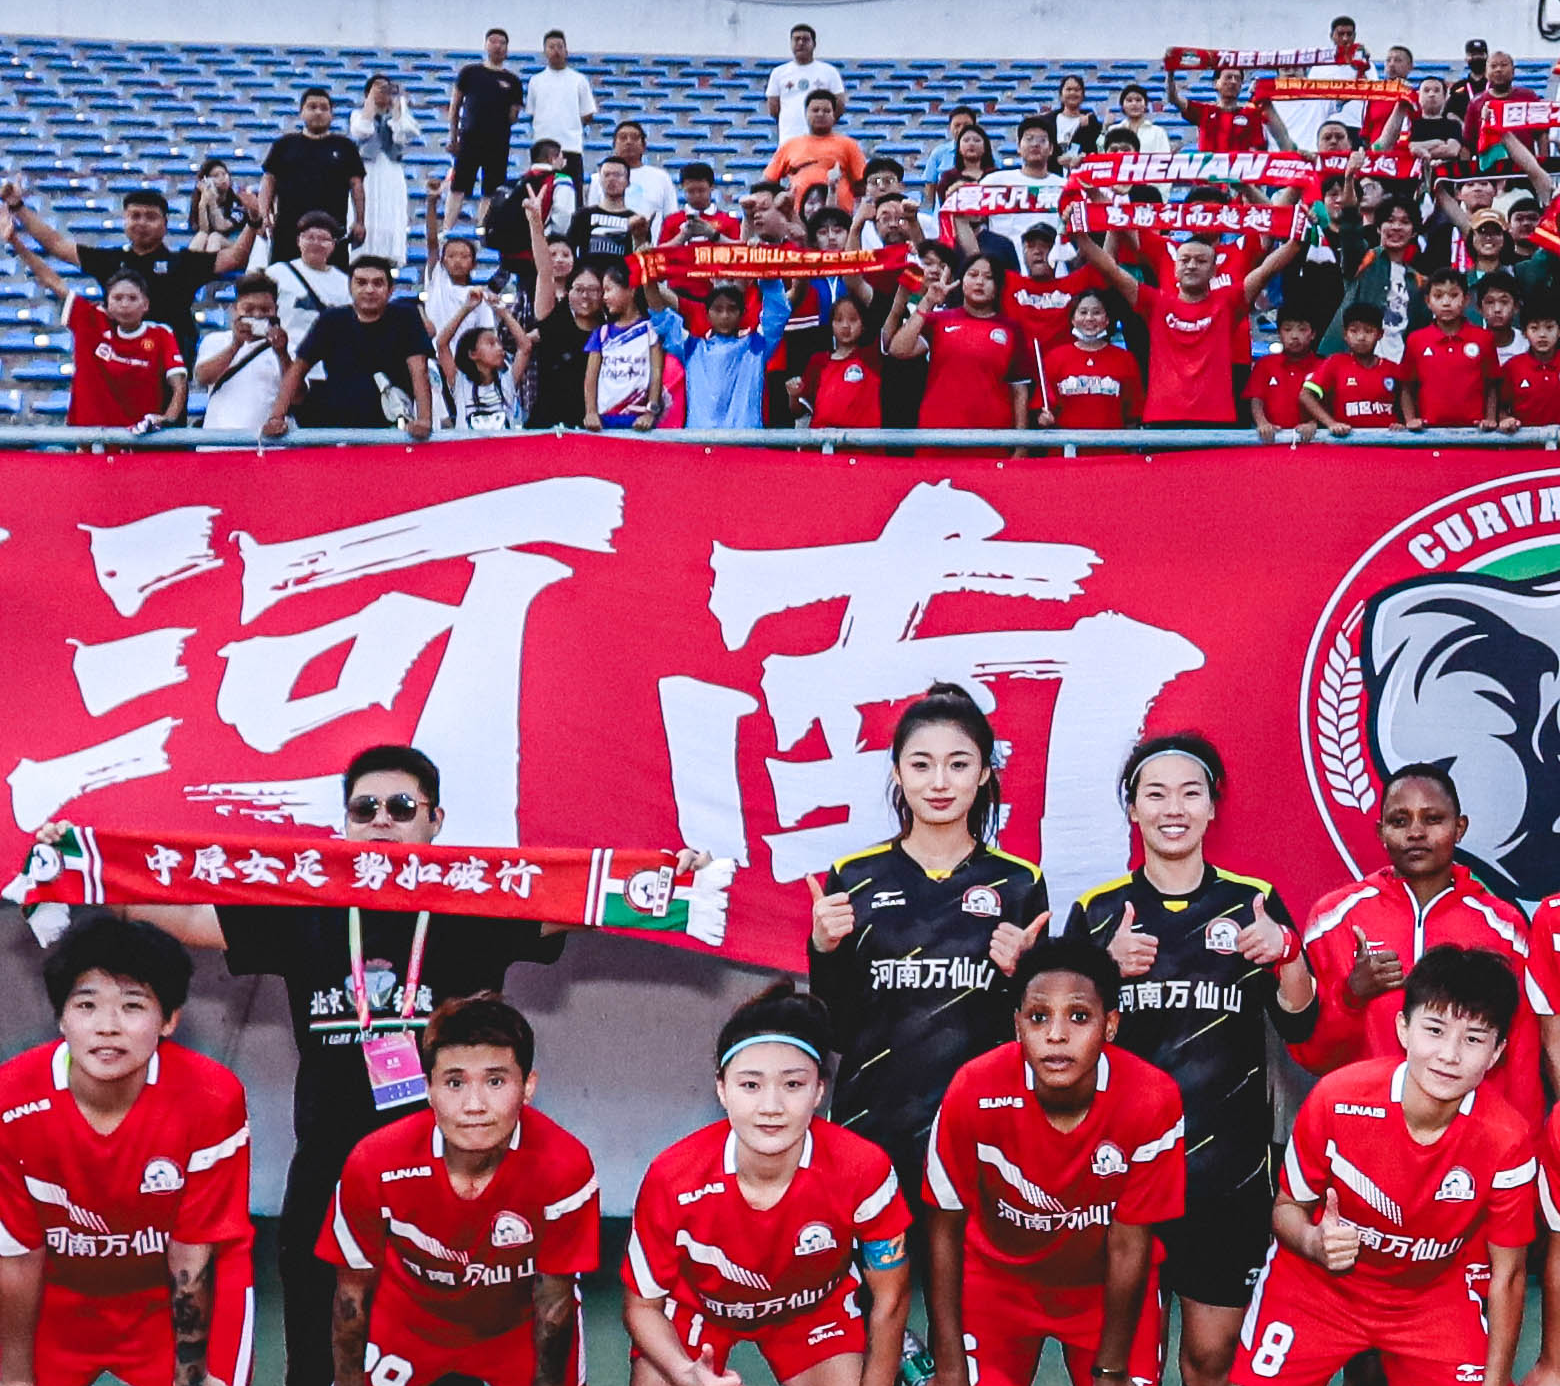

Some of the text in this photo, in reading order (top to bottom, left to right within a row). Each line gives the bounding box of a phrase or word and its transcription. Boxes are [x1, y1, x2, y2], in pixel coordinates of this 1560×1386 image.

[1116, 152, 1270, 182] HENAN
[143, 843, 544, 901] 中原女足 势如破竹
[869, 956, 997, 992] 河南万仙山
[1334, 1102, 1386, 1119] SUNAIS
[45, 1225, 171, 1258] 河南万仙
[1250, 1320, 1295, 1378] 8
